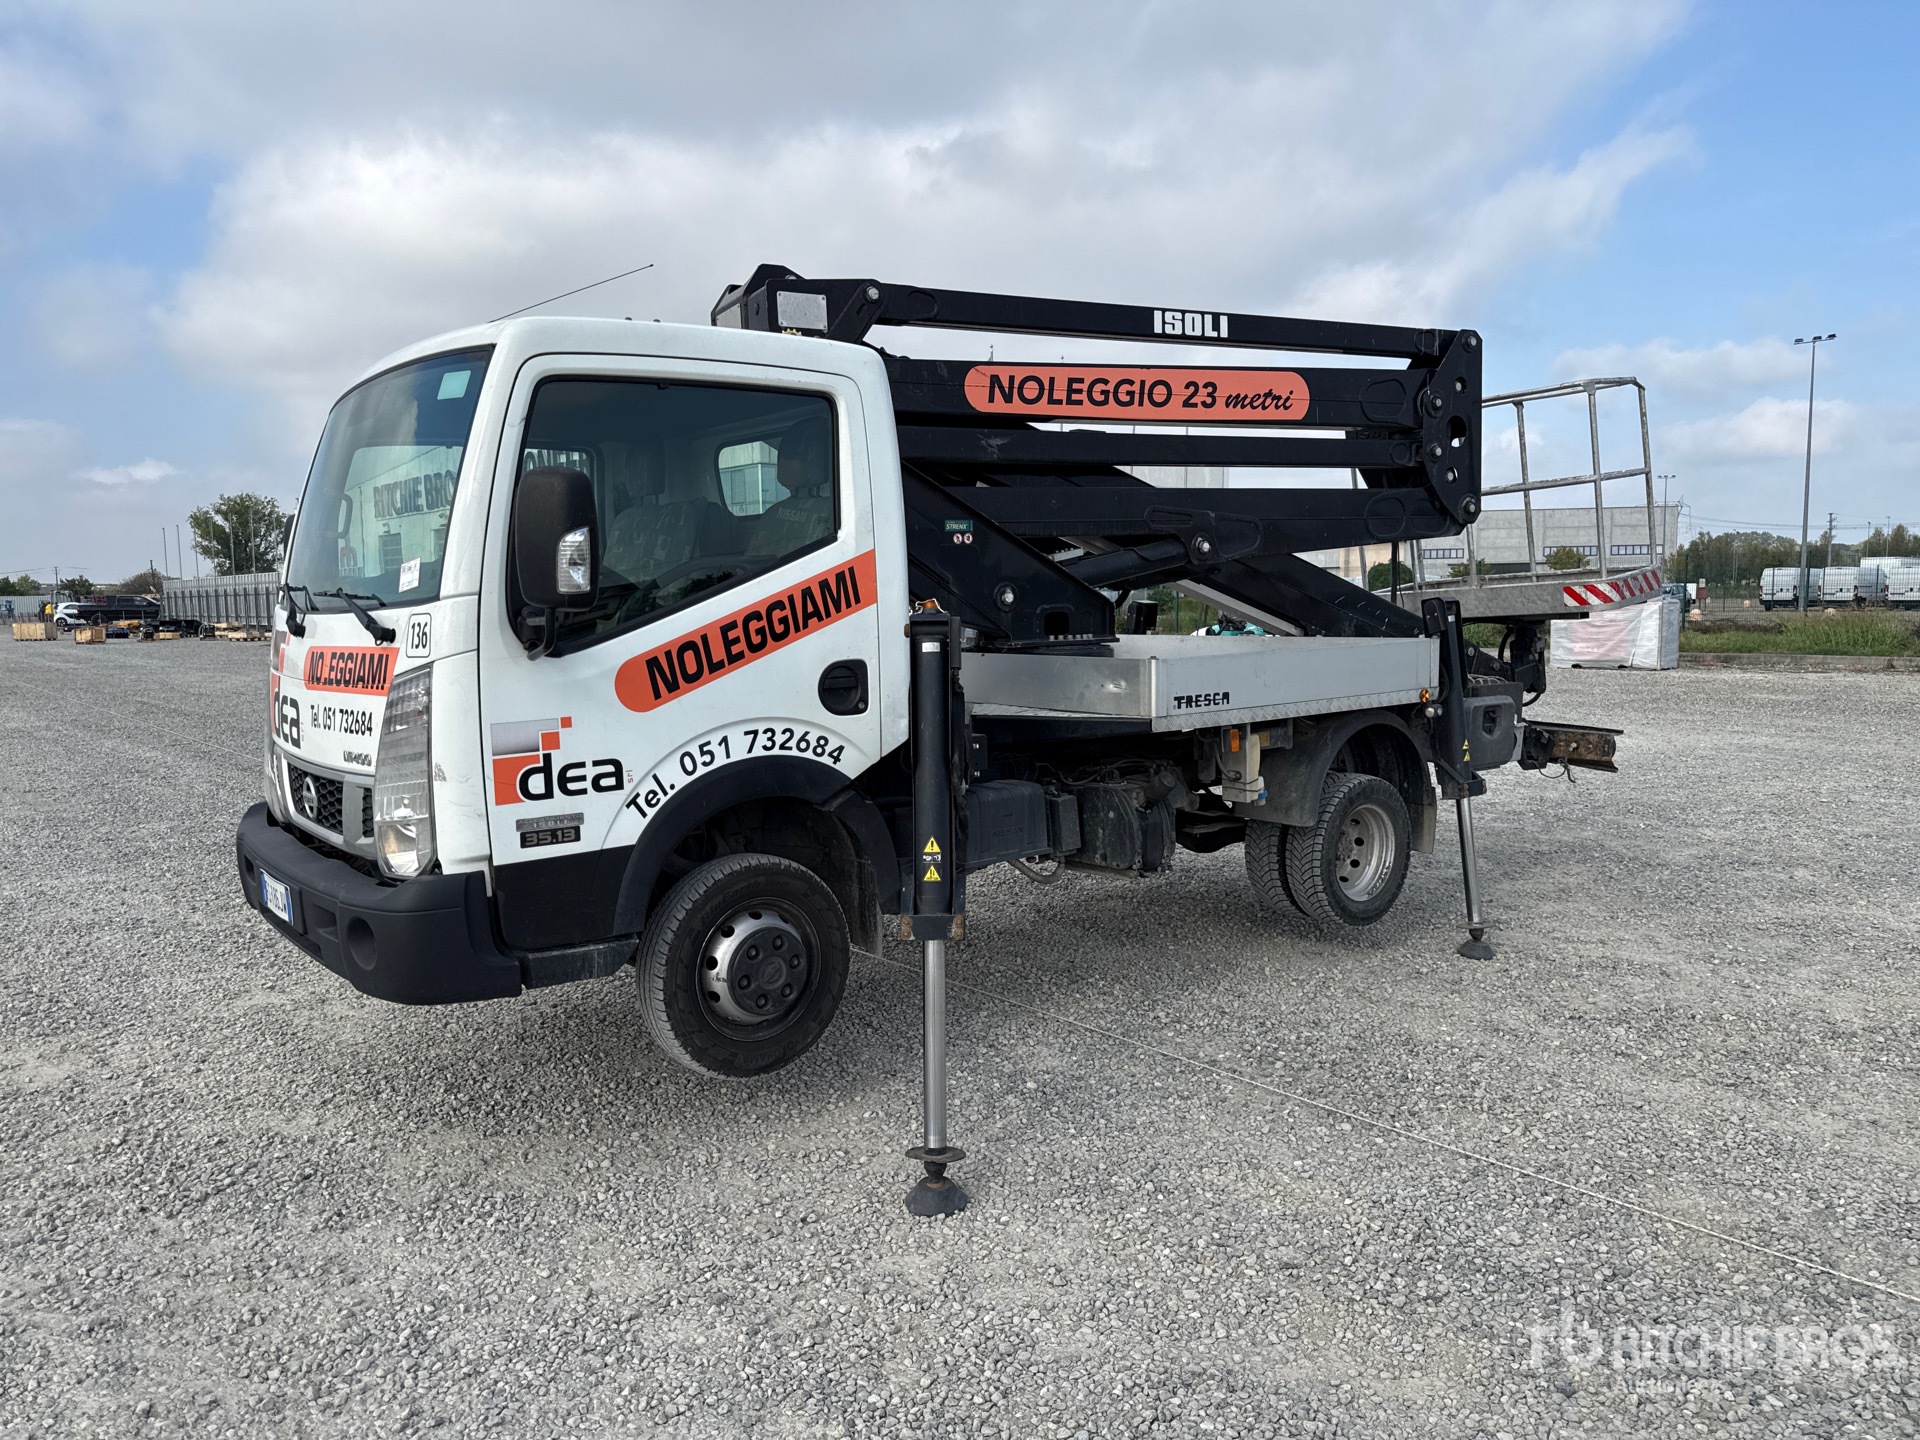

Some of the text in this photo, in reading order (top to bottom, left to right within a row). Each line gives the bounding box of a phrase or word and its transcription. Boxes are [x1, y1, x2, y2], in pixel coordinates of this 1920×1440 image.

[1153, 309, 1229, 338] ISOLI
[988, 374, 1294, 411] NOLEGGIO 23 metri
[373, 476, 425, 519] RITCHIE
[777, 507, 808, 523] NISSAN
[411, 621, 429, 650] 136
[645, 565, 862, 701] NOLEGGIAMI
[310, 704, 321, 729] Tel.
[322, 706, 337, 732] 051
[339, 708, 373, 737] 732684
[518, 752, 625, 802] dea
[625, 727, 846, 820] Tel. 051 732684
[525, 828, 576, 846] 35.13
